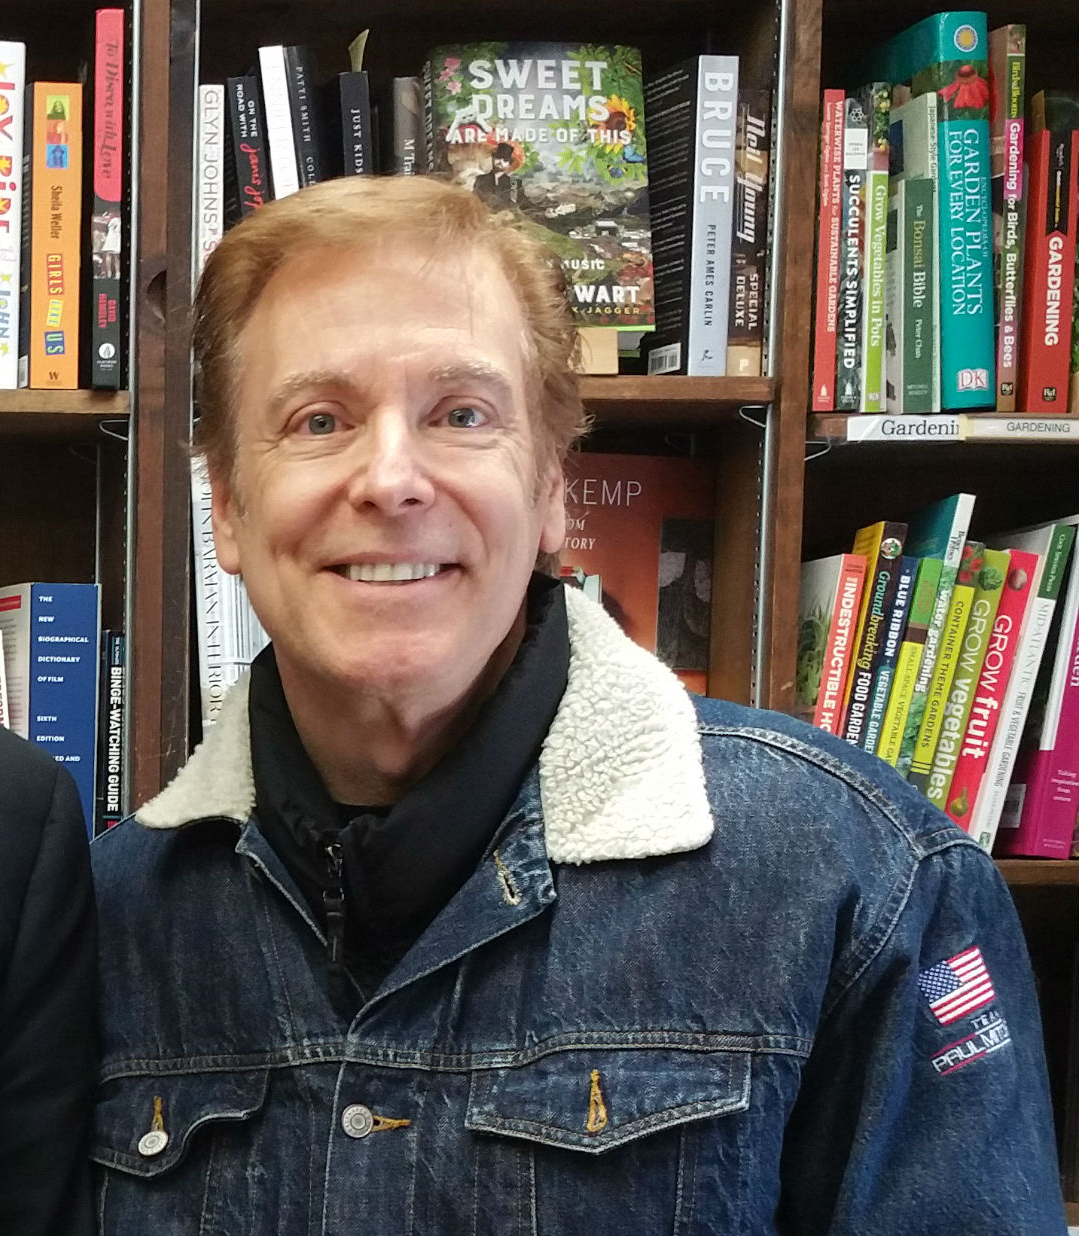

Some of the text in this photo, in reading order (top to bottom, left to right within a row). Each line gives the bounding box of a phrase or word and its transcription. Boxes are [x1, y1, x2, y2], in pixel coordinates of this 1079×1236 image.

[295, 66, 311, 142] PATTI SMITH
[468, 59, 608, 91] SWEET
[472, 94, 611, 122] DREAMS
[204, 90, 219, 145] GLYN
[236, 83, 247, 138] ROAD WITH
[248, 100, 258, 137] ON THE
[350, 107, 364, 174] JUST KIDS
[451, 127, 632, 145] ARE MADE OF THIS
[700, 71, 734, 203] BRUCE
[203, 153, 219, 224] JOHNS
[239, 142, 262, 186] janis
[736, 114, 766, 244] Neil Young
[51, 185, 64, 239] Sheila Weller
[827, 101, 843, 333] WATERWISE PLANTS SUSTAINABLE GARDENS
[913, 219, 926, 268] Bonsai
[948, 130, 966, 315] FOR EVERY LOCATION
[958, 128, 983, 315] GARDEN PLANTS
[1003, 122, 1021, 368] Gardening for Birds, Butterflies & Bees
[703, 224, 716, 327] PETER AMES CARLIN
[843, 174, 861, 369] SUCCULENTS SIMPLIFIED
[870, 185, 887, 347] Grow Vegetables in Pots
[913, 271, 926, 308] Bible
[1044, 236, 1064, 347] GARDENING
[46, 254, 64, 354] GIRLS LIKE US
[586, 306, 641, 315] JAGGER
[734, 275, 746, 327] DELUXE
[748, 273, 759, 330] SPECIAL
[914, 318, 923, 359] Peter Chan
[960, 369, 985, 386] DK
[1006, 422, 1071, 433] GARDENING
[564, 478, 642, 507] KEMP
[854, 570, 891, 701] Groundbreaking FOOD
[935, 590, 951, 627] water
[823, 583, 858, 710] INDESTRUCTIBLE
[871, 575, 911, 720] BLUE RIBBON VEGETABLE
[915, 628, 939, 693] gardening
[921, 600, 964, 748] CONTAINER THEME GARDENS
[979, 614, 1013, 693] GROW
[889, 701, 906, 747] VEGETABLE
[926, 599, 991, 800] GROW vegetables
[962, 696, 998, 760] fruit
[106, 667, 123, 812] BINGE-WATCHING GUIDE
[993, 692, 1027, 787] FRUIT VEGETABLE GARDENING
[931, 1040, 986, 1074] PAUL
